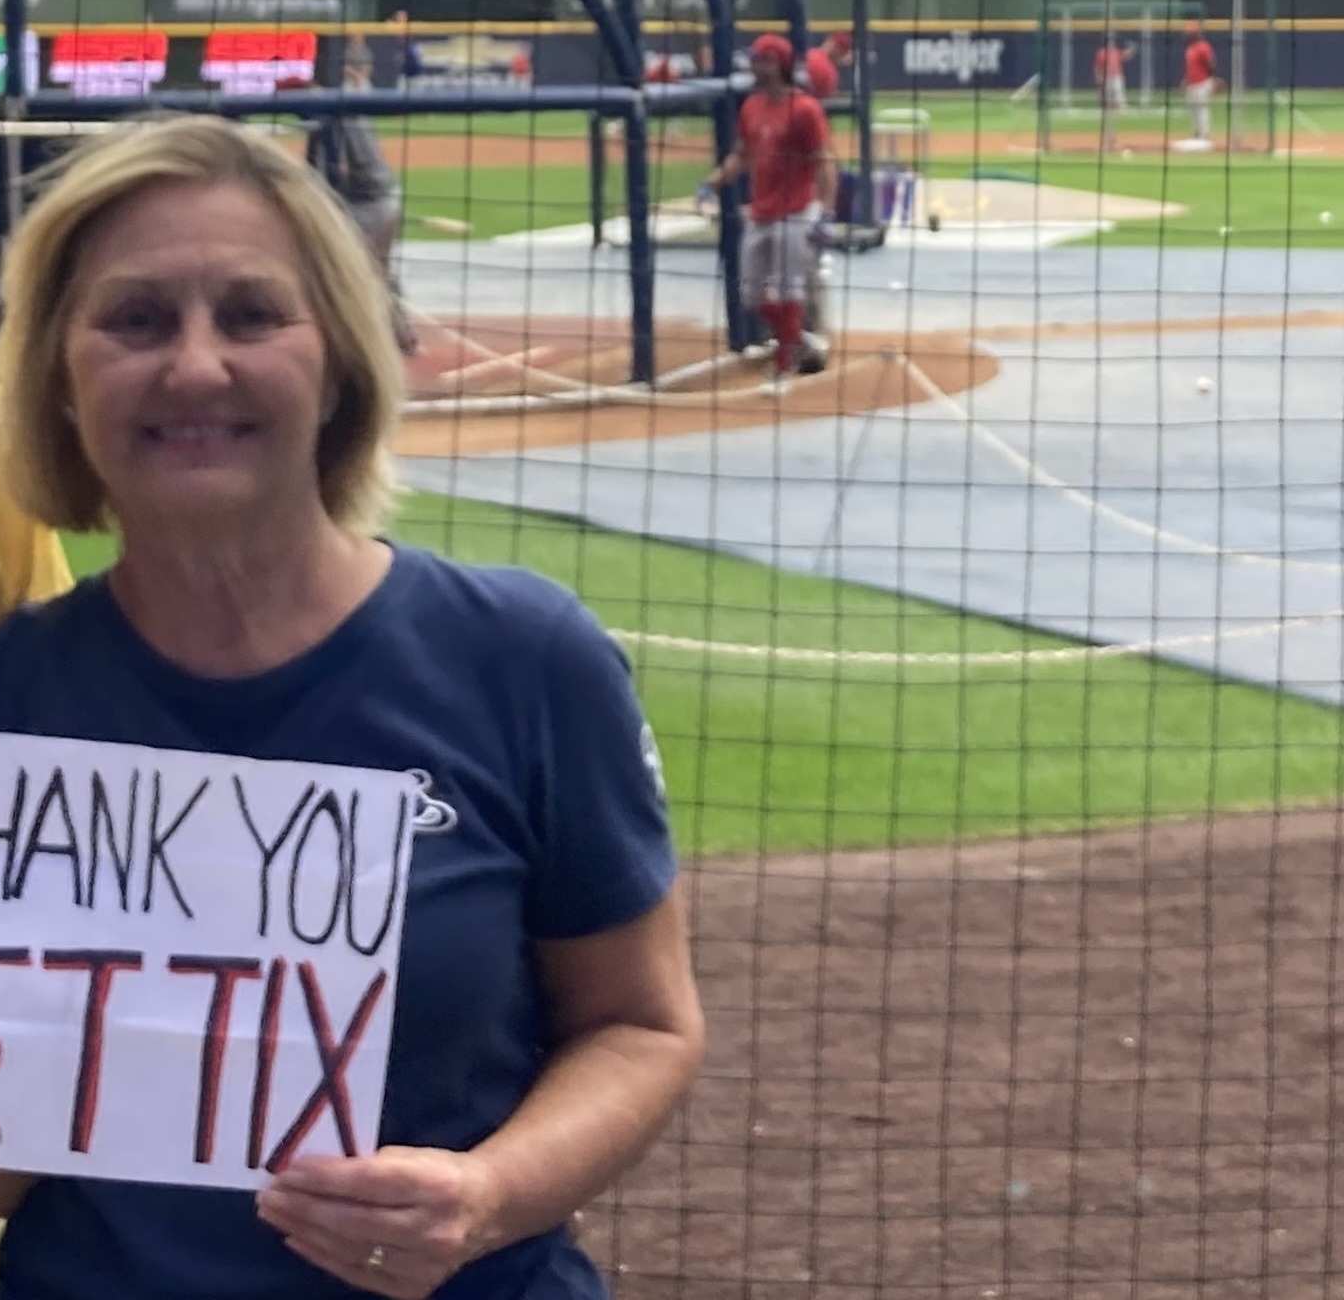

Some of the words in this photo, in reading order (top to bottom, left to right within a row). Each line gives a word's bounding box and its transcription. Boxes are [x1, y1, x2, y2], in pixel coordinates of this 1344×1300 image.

[903, 29, 1005, 84] meijer
[232, 771, 408, 957] YOU
[167, 953, 388, 1174] TIX
